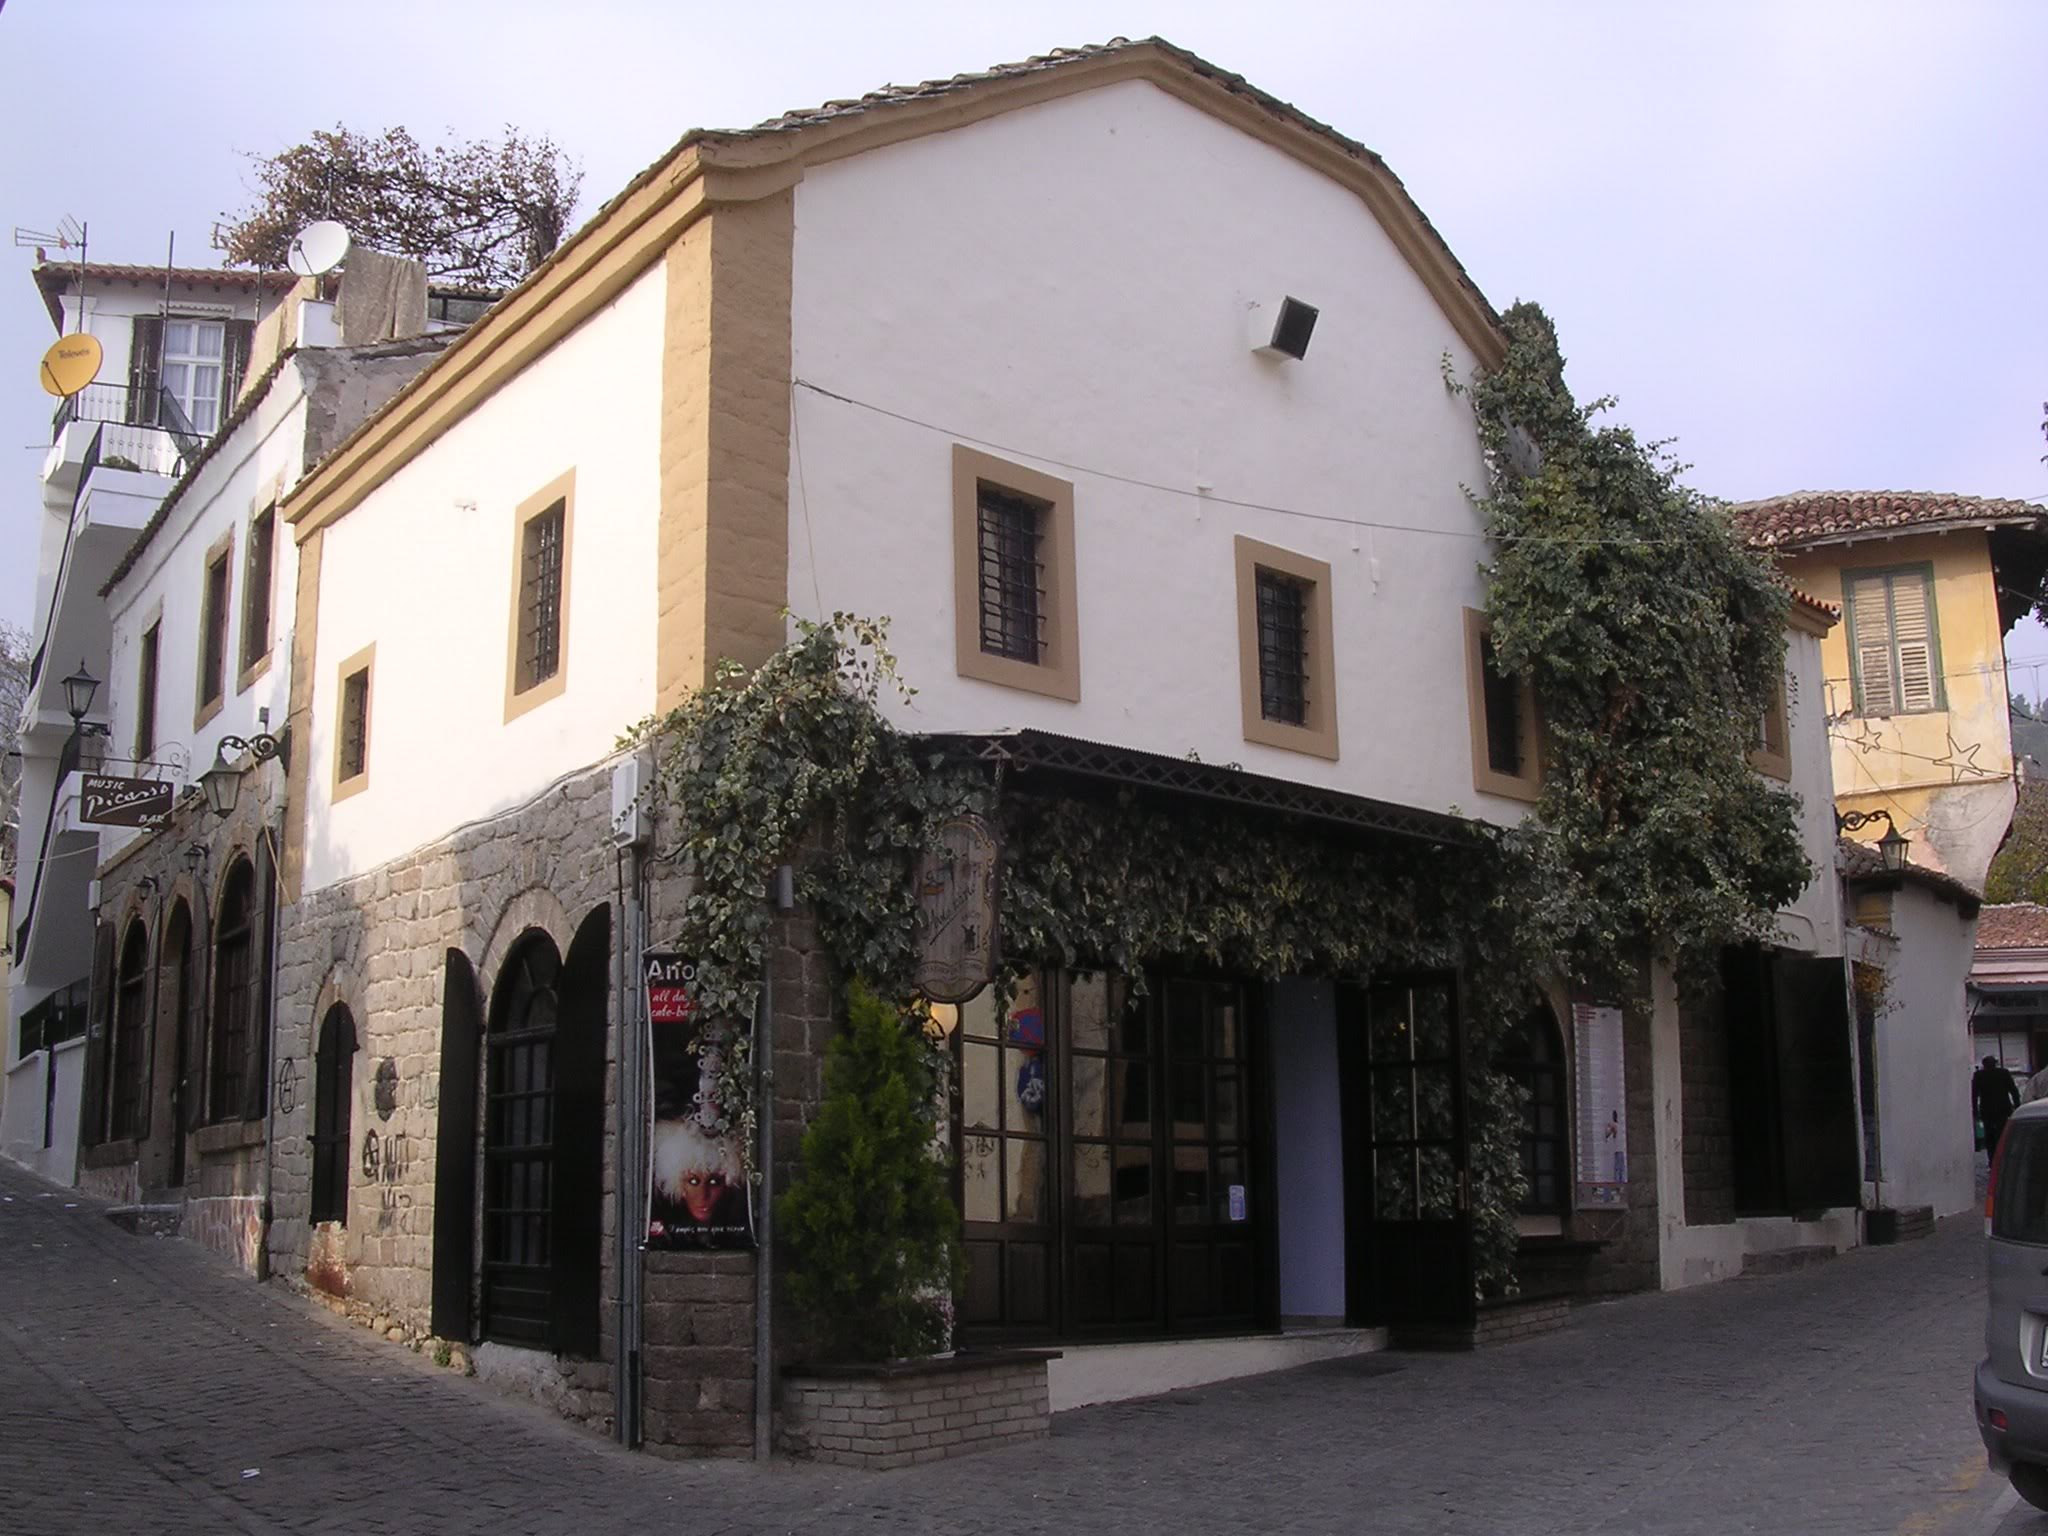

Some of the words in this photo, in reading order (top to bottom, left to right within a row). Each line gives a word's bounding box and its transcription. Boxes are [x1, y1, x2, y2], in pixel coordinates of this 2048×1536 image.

[87, 778, 125, 790] MUSIC
[138, 814, 165, 824] BAR
[652, 990, 671, 1002] all
[651, 1004, 689, 1017] cafe-ba
